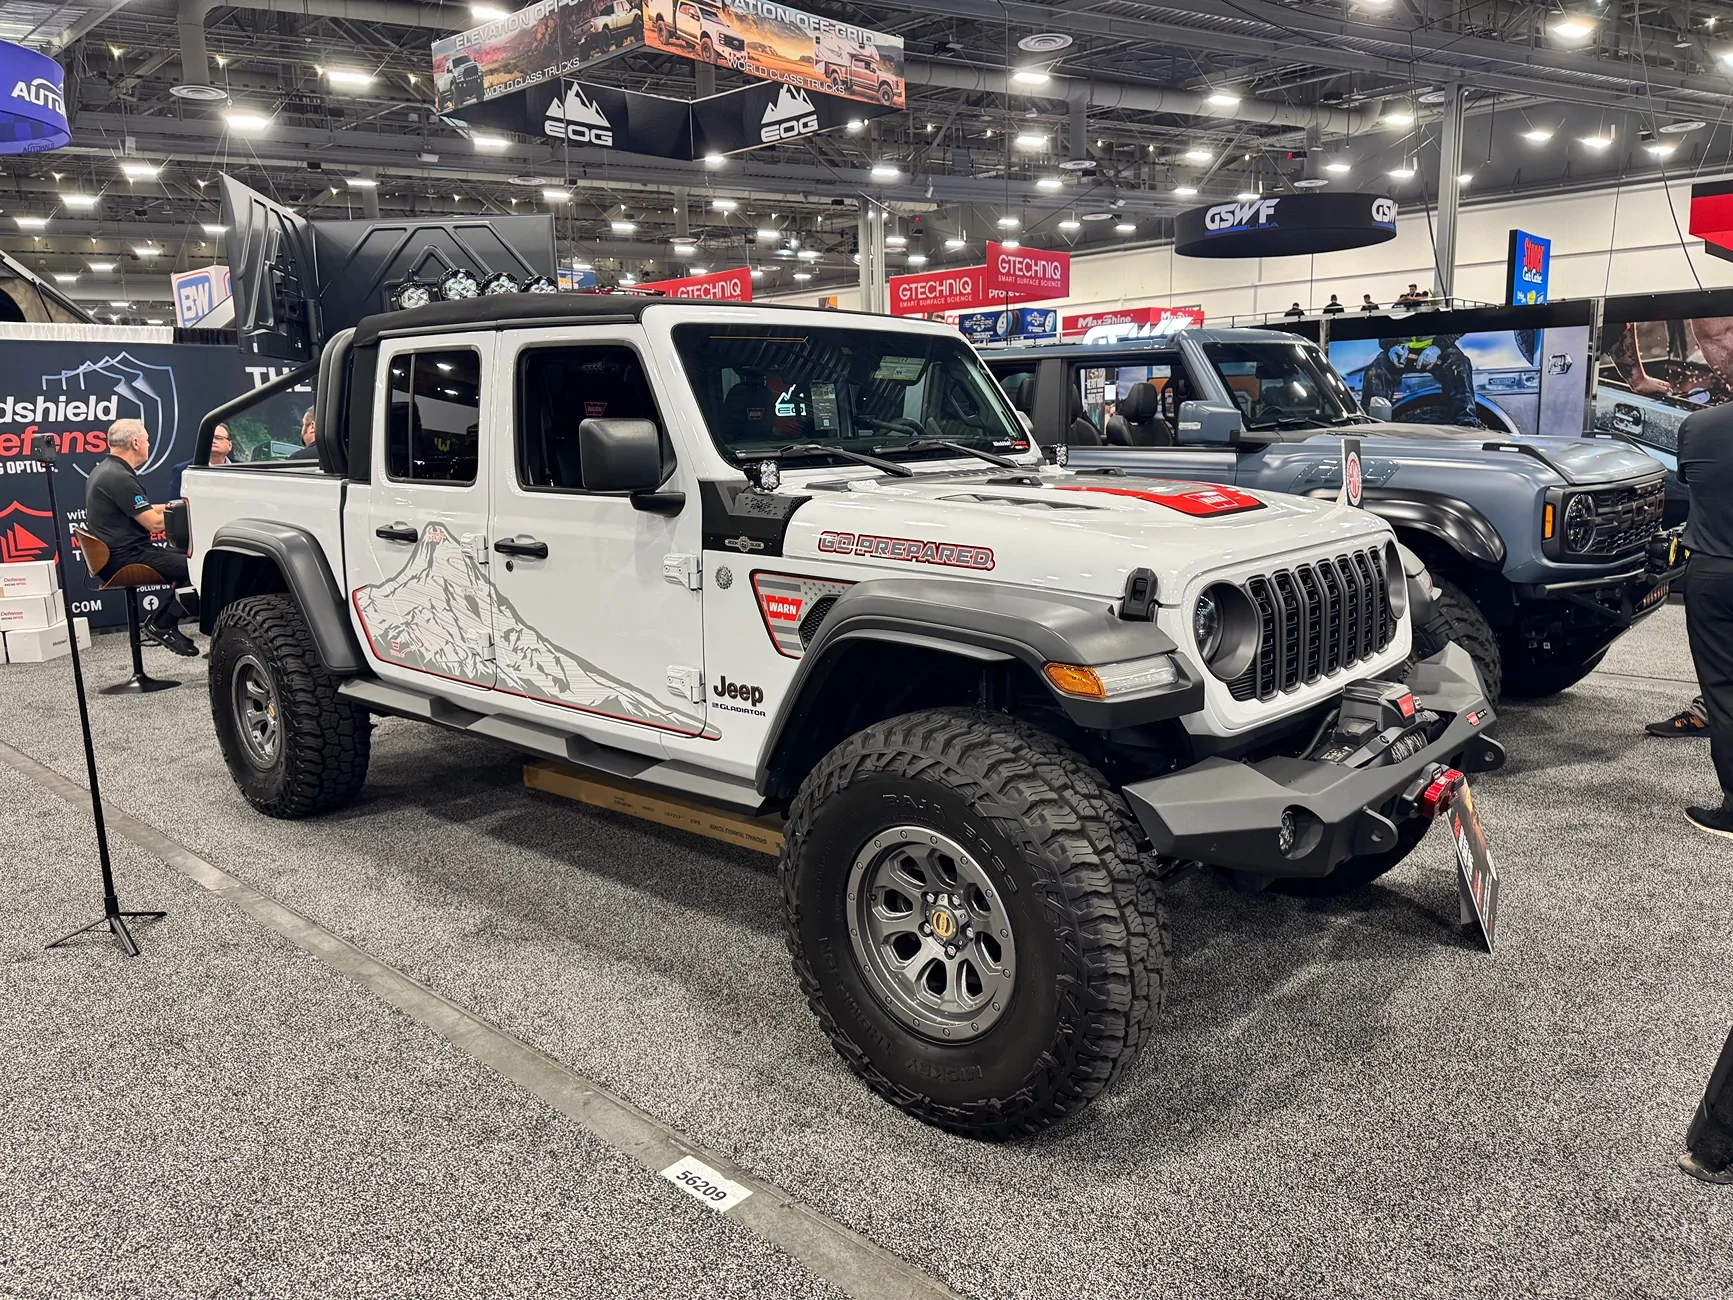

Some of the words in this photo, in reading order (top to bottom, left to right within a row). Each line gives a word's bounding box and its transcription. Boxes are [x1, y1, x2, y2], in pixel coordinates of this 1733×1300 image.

[455, 13, 530, 49] ELEVATION
[484, 81, 513, 97] WORLD
[515, 71, 542, 88] CLASS
[543, 57, 580, 77] TRUCKS
[727, 58, 767, 77] WORLD
[770, 68, 804, 86] CLASS
[805, 77, 846, 95] TRUCKS
[544, 119, 613, 147] EOG
[761, 114, 819, 143] EOG
[1205, 198, 1280, 231] GSWF
[1247, 221, 1280, 230] USA
[998, 254, 1062, 280] GTECHNIQ
[998, 274, 1016, 284] SMART
[1017, 276, 1039, 286] SURFACE
[1040, 279, 1062, 288] SCIENCE
[678, 278, 742, 298] GTECHNIQ
[899, 277, 972, 301] GTECHNIQ
[899, 300, 918, 308] SMART
[919, 298, 945, 306] SURFACE
[946, 295, 973, 303] SCIENCE
[0, 425, 109, 457] efns
[67, 508, 88, 520] wit
[820, 533, 853, 552] GO
[858, 536, 992, 568] PREPARED
[769, 601, 797, 615] WARN
[713, 675, 764, 708] Jeep
[720, 703, 766, 717] GLADIATOR
[675, 1170, 727, 1202] 56209
